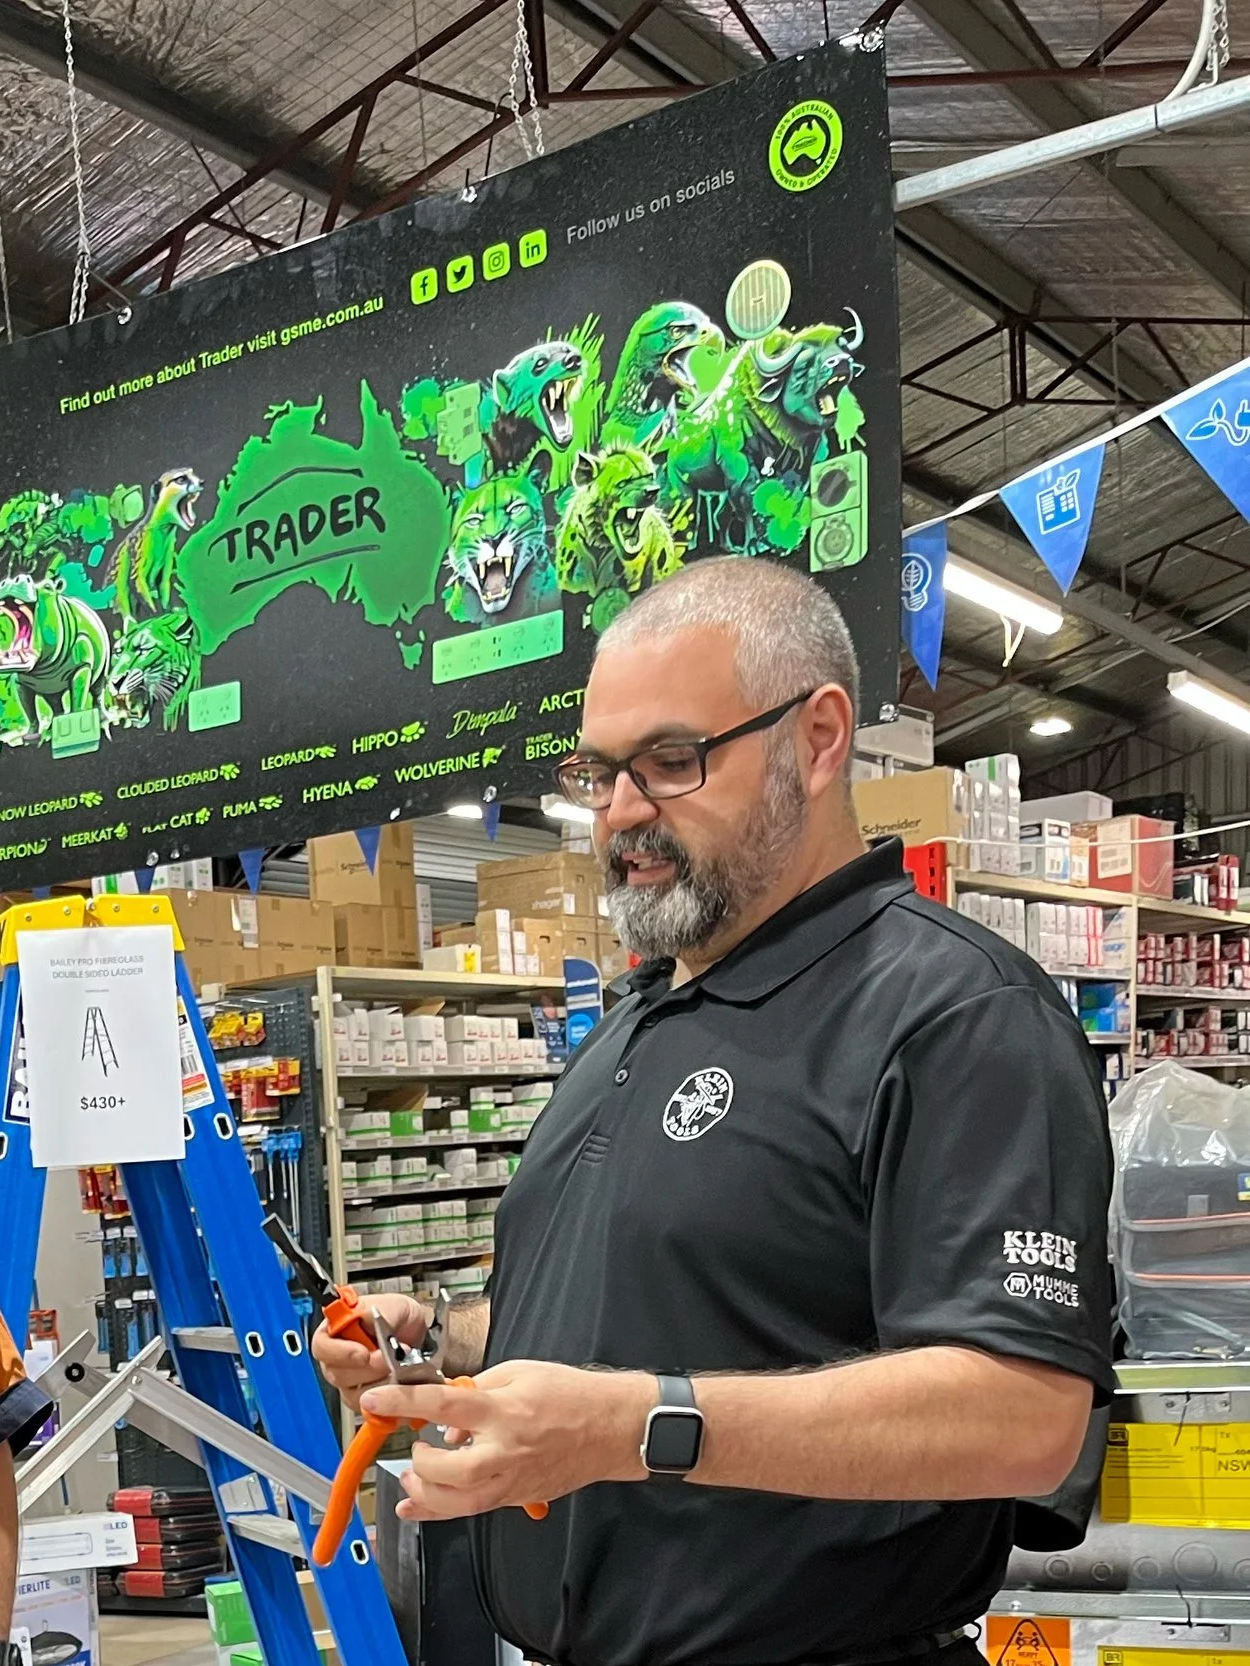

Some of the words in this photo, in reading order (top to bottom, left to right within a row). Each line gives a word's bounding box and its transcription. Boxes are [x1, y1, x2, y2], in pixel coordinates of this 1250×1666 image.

[566, 209, 620, 244] Follow
[624, 201, 645, 224] us
[650, 192, 672, 213] on
[675, 168, 736, 205] socials
[59, 392, 90, 414] Find
[93, 385, 116, 404] out
[119, 374, 153, 396] more
[156, 358, 196, 384] about
[199, 345, 244, 369] Trader
[245, 329, 277, 353] visit
[280, 296, 384, 347] gsme.com.au
[209, 488, 386, 566] TRADER
[27, 796, 79, 818] LEOPARD
[117, 778, 169, 800] CLOUDED
[170, 768, 219, 790] LEOPARD
[261, 748, 315, 771] LEOPARD
[352, 730, 398, 755] HIPPO
[61, 827, 114, 849] MEERKAT
[170, 812, 193, 830] CAT
[223, 800, 257, 818] PUMA
[303, 780, 354, 804] HYENA
[394, 751, 481, 784] WOLVERINE
[525, 736, 576, 761] BISON
[861, 818, 922, 835] Schneider
[50, 957, 76, 967] BAILEY
[78, 957, 93, 966] PRO
[95, 955, 144, 966] FIBREGLASS
[52, 969, 84, 979] DOUBLE
[85, 968, 109, 978] SIDED
[111, 967, 144, 977] LADDER
[694, 1073, 729, 1095] KLEIN
[80, 1096, 126, 1110] $430+
[1003, 1230, 1077, 1260] KLEIN
[1003, 1247, 1076, 1273] TOOLS
[1032, 1274, 1079, 1297] MUMME
[1033, 1286, 1080, 1307] TOOLS
